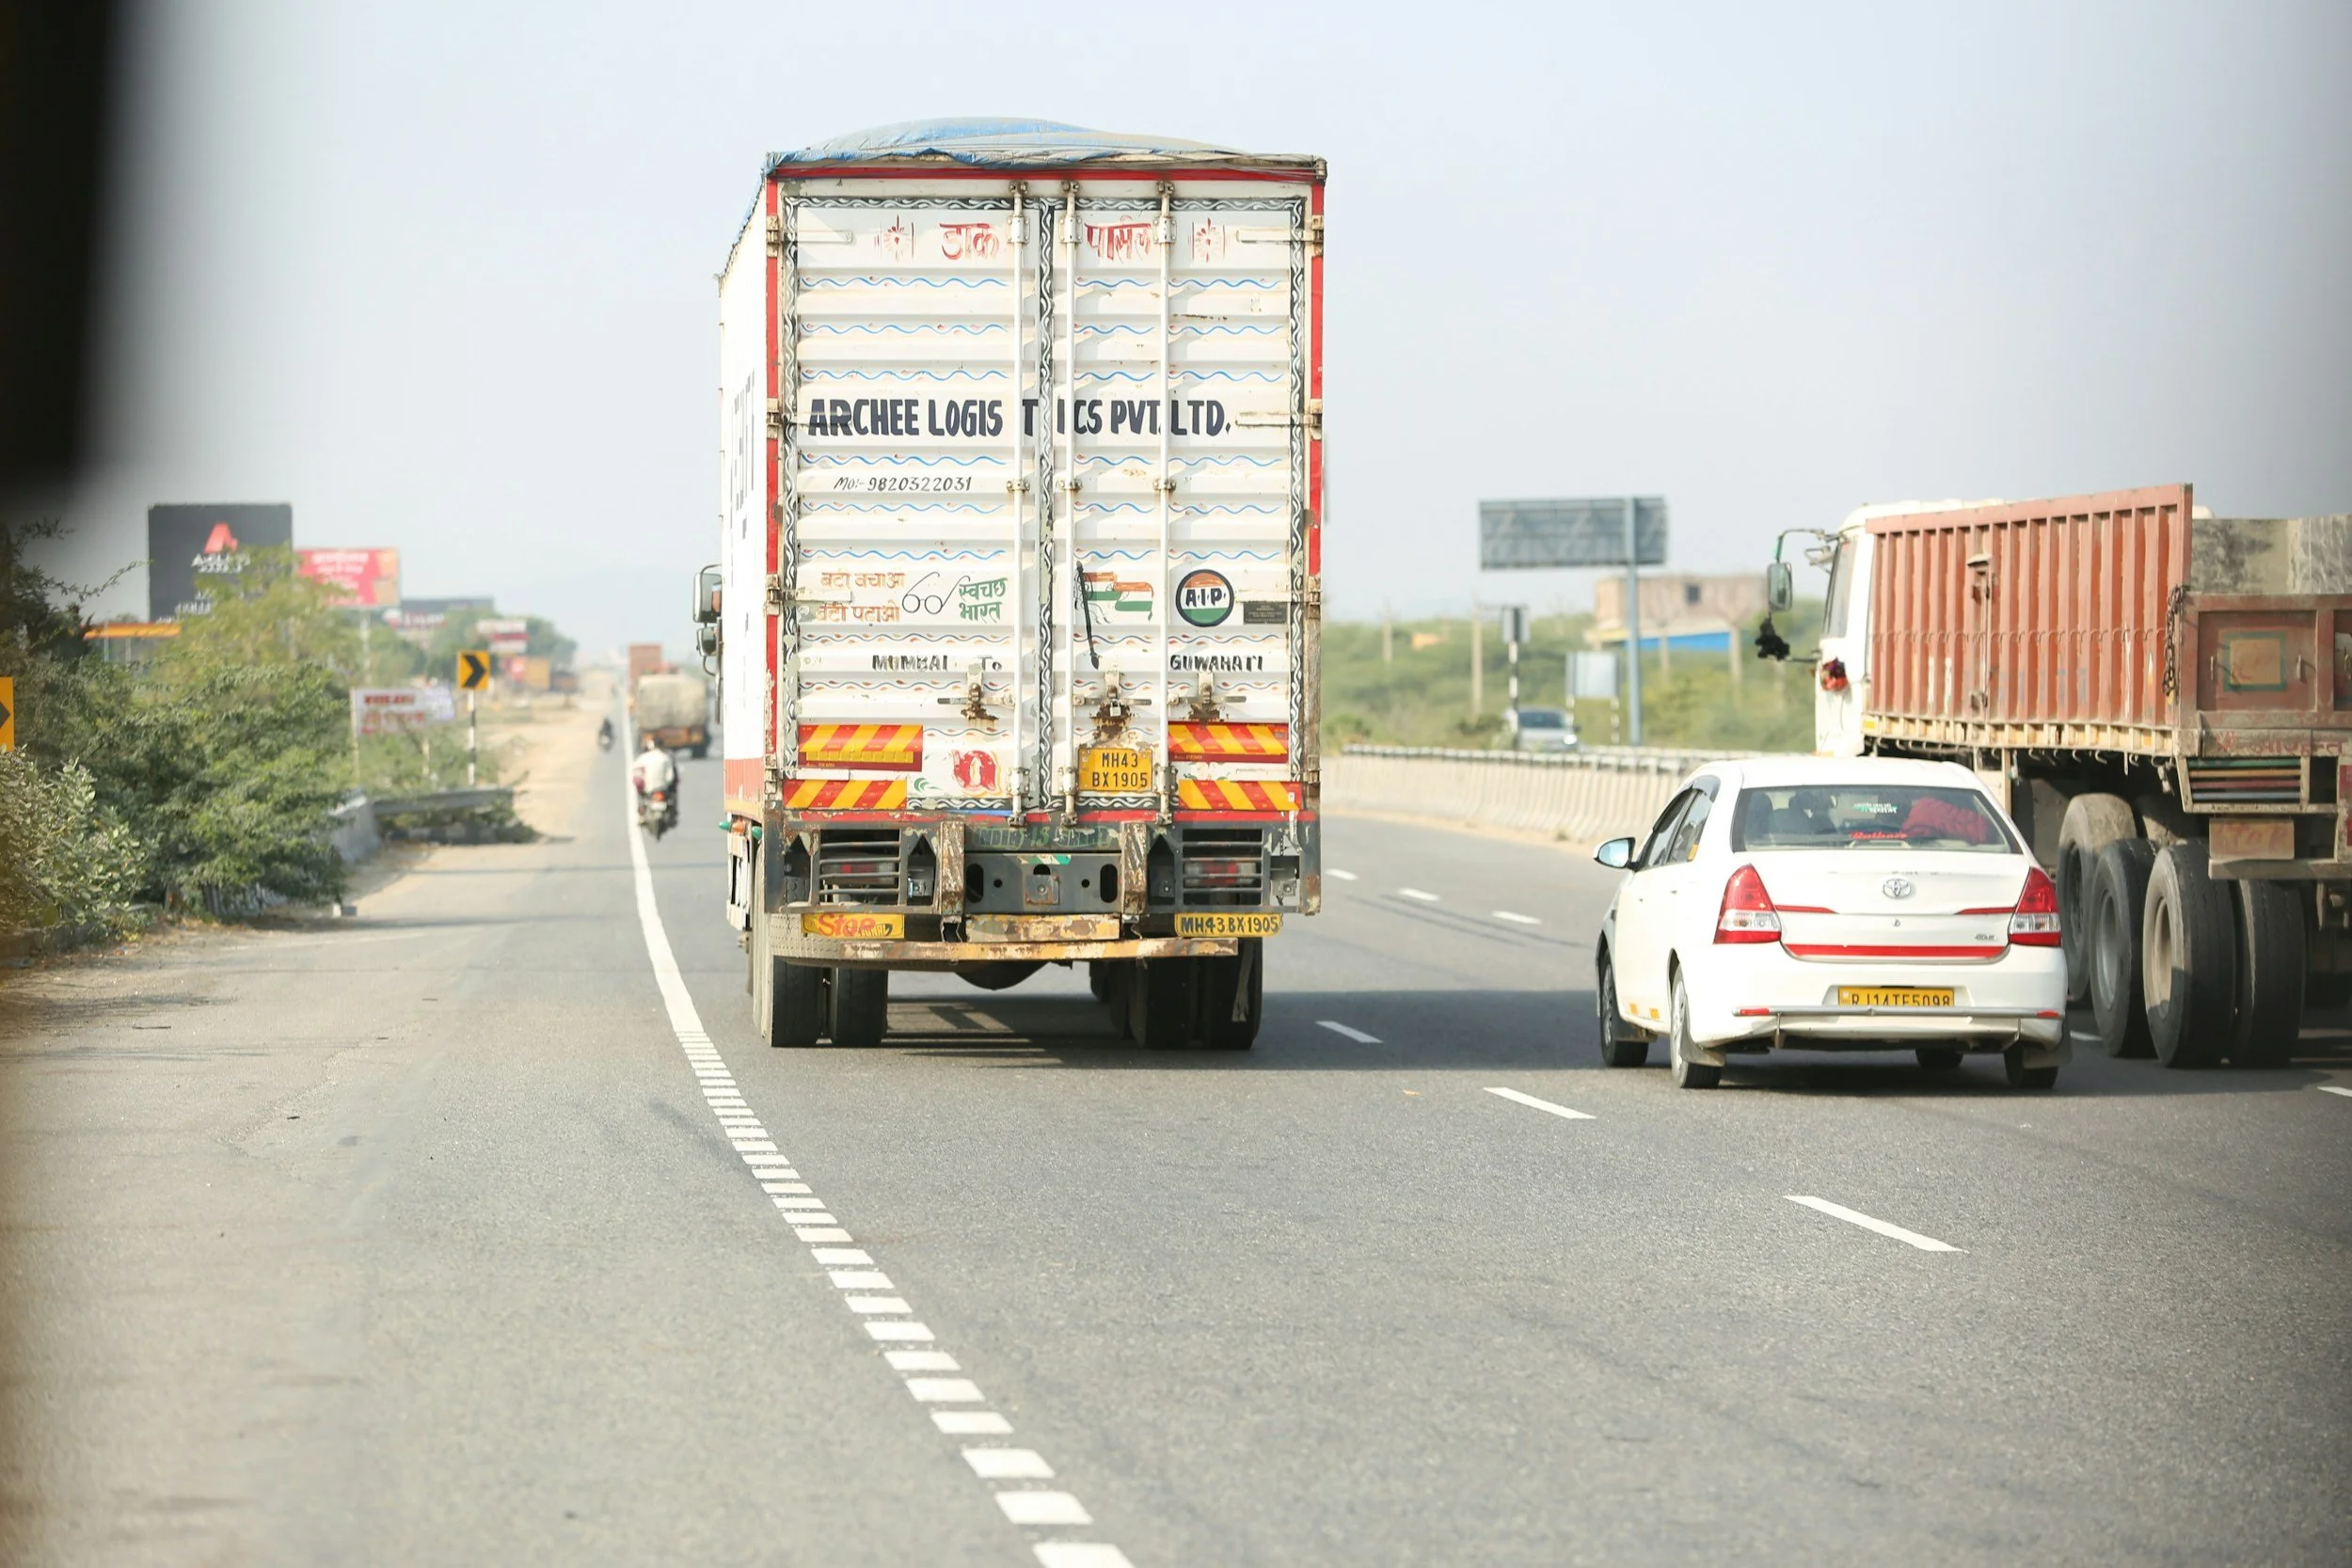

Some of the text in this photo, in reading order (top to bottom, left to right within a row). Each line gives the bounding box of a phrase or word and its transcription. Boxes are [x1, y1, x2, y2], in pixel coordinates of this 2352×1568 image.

[808, 399, 920, 436] ARCHEE
[1171, 400, 1232, 437] LTD.
[959, 601, 1003, 624] भारत
[1169, 655, 1263, 673] GUWAHATI
[1102, 752, 1138, 768] MH43
[1092, 771, 1148, 788] BX1905
